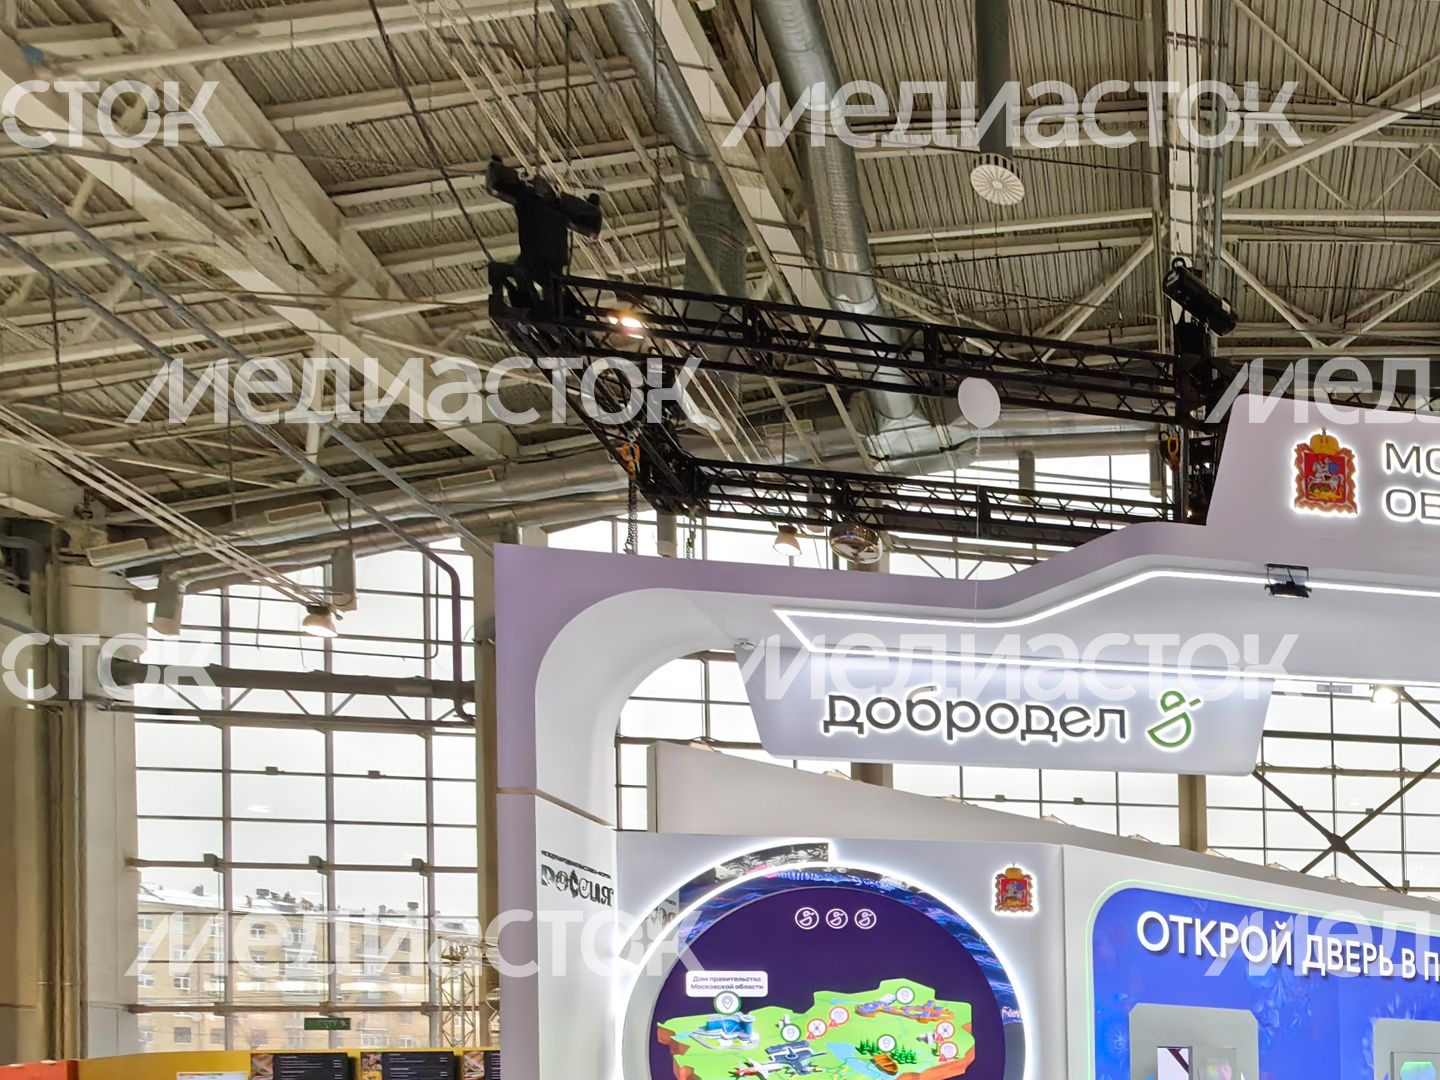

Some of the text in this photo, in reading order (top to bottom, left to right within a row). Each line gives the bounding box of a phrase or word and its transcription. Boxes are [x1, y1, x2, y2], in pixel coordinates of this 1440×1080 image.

[1136, 910, 1293, 967] ОТКРОЙ
[1301, 934, 1394, 978] ДВЕРЬ
[1401, 947, 1416, 980] В
[692, 975, 709, 983] Дом
